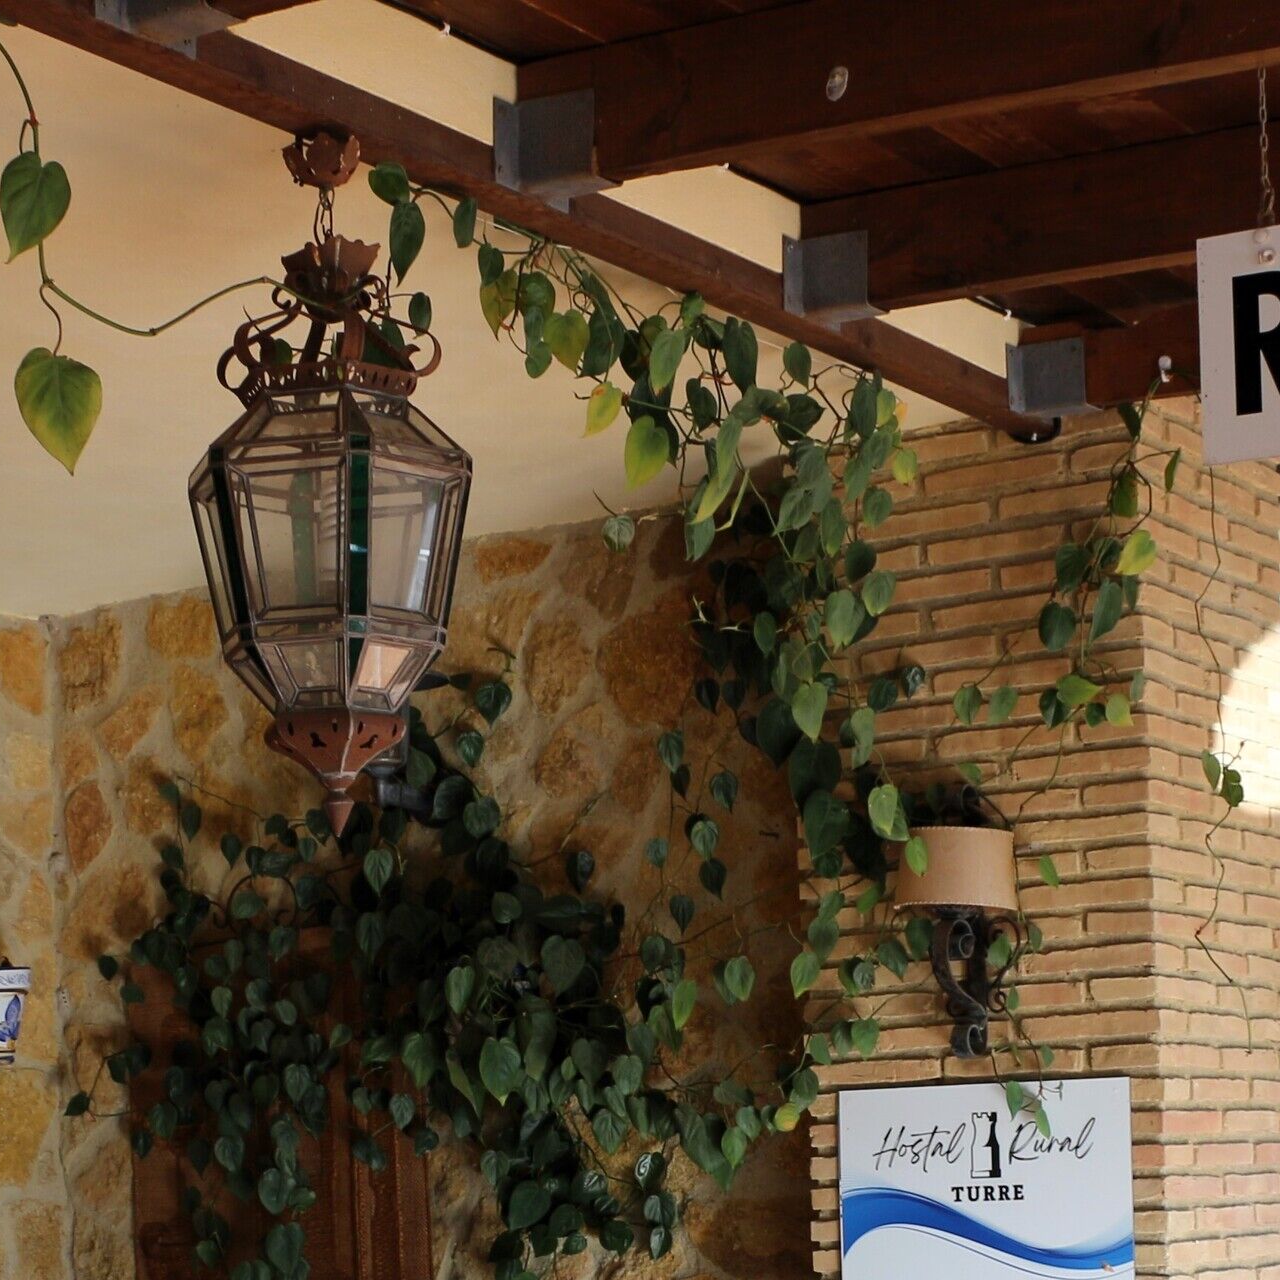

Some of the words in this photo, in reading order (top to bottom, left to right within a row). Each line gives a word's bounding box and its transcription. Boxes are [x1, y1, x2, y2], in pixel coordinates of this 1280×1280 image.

[873, 1123, 966, 1173] Hostal
[1009, 1117, 1096, 1165] Rural
[951, 1184, 1025, 1202] TURRE
